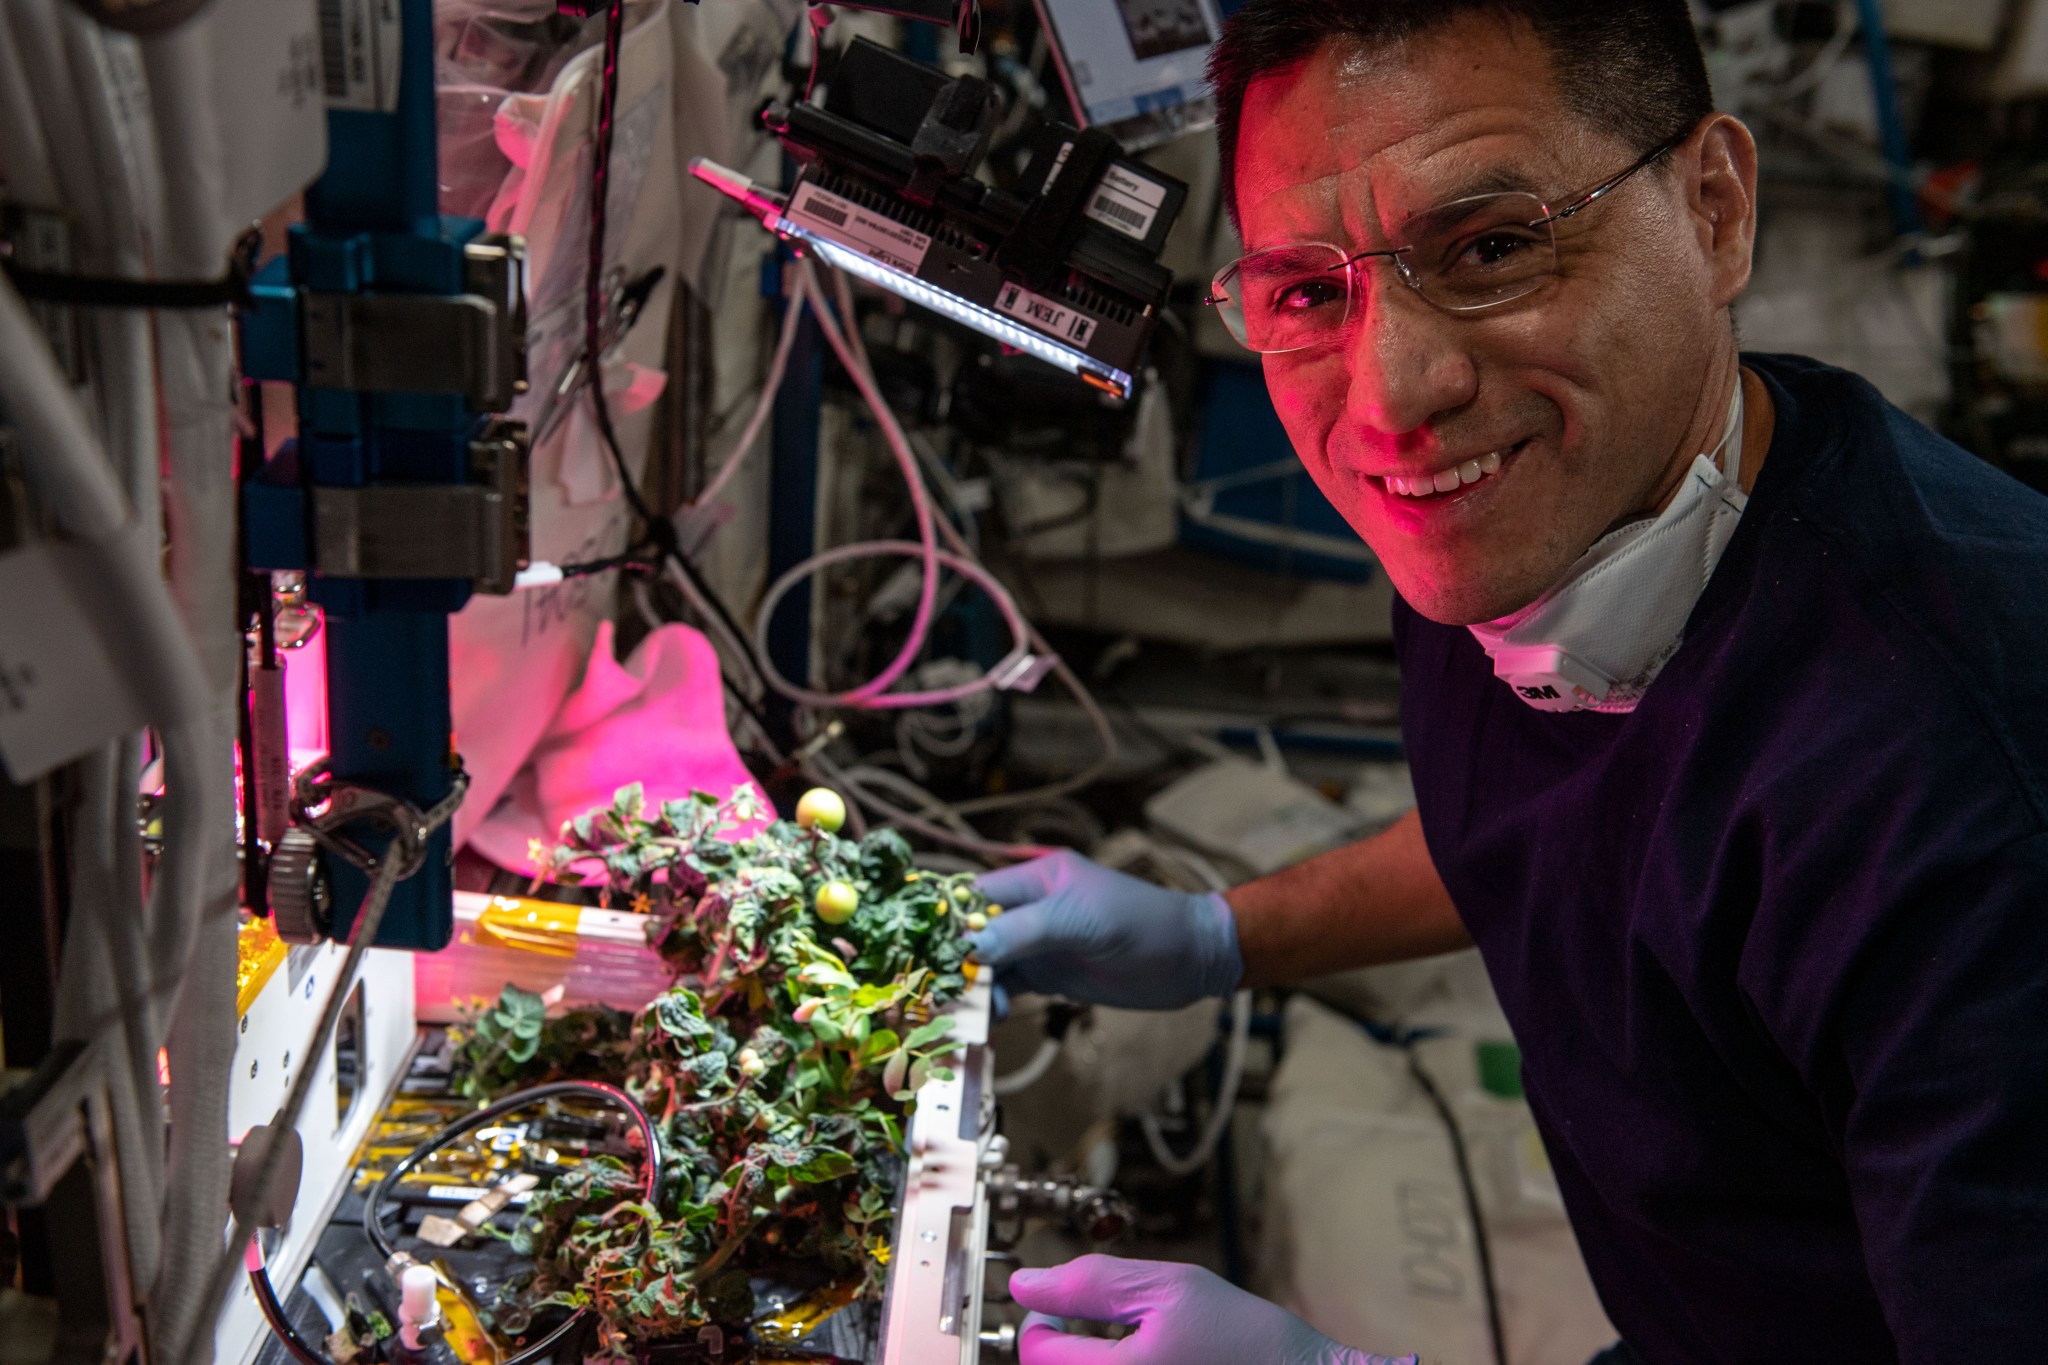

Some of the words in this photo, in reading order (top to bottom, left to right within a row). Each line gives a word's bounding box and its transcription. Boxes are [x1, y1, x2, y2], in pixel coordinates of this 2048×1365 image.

[1109, 171, 1139, 192] Battery
[1024, 300, 1065, 326] JEM
[1518, 685, 1561, 700] 3M
